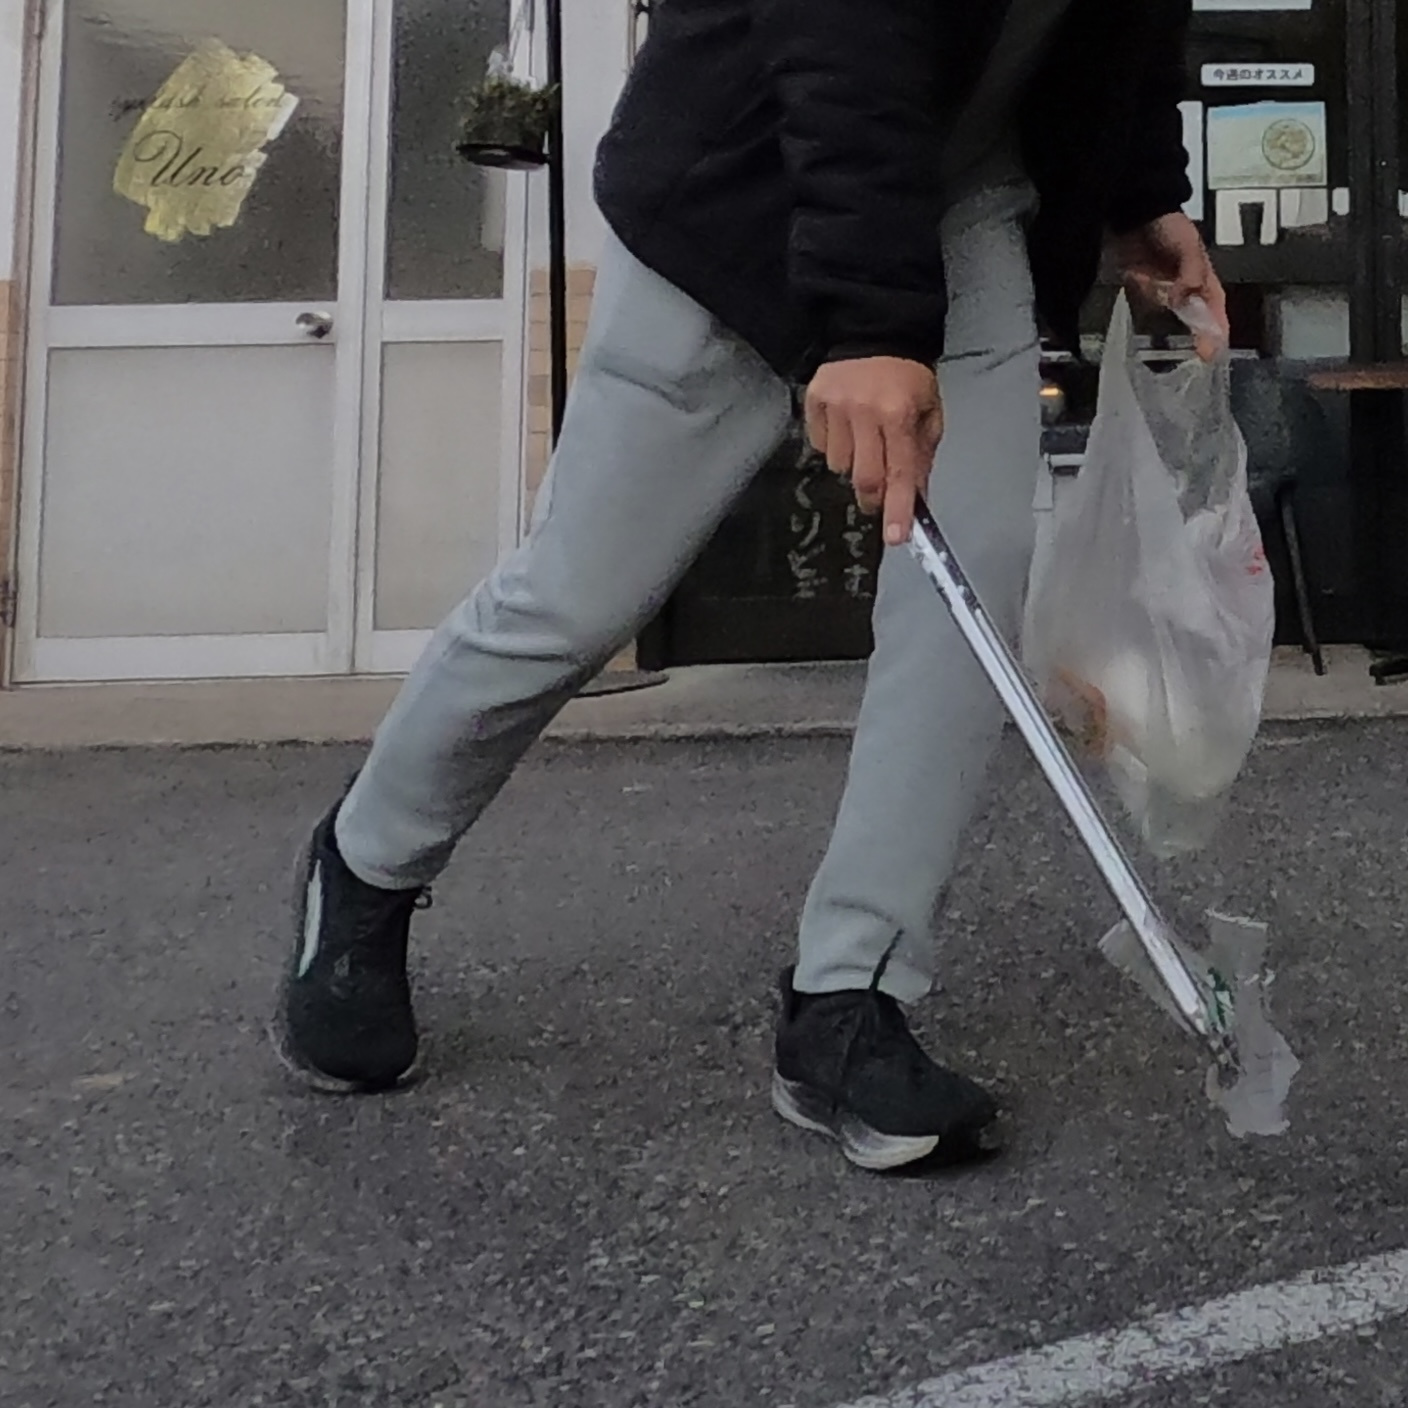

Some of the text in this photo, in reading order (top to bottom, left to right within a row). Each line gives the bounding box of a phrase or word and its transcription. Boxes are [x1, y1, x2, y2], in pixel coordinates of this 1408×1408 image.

[1213, 67, 1303, 81] 今週のオススメ
[132, 129, 248, 188] Uno
